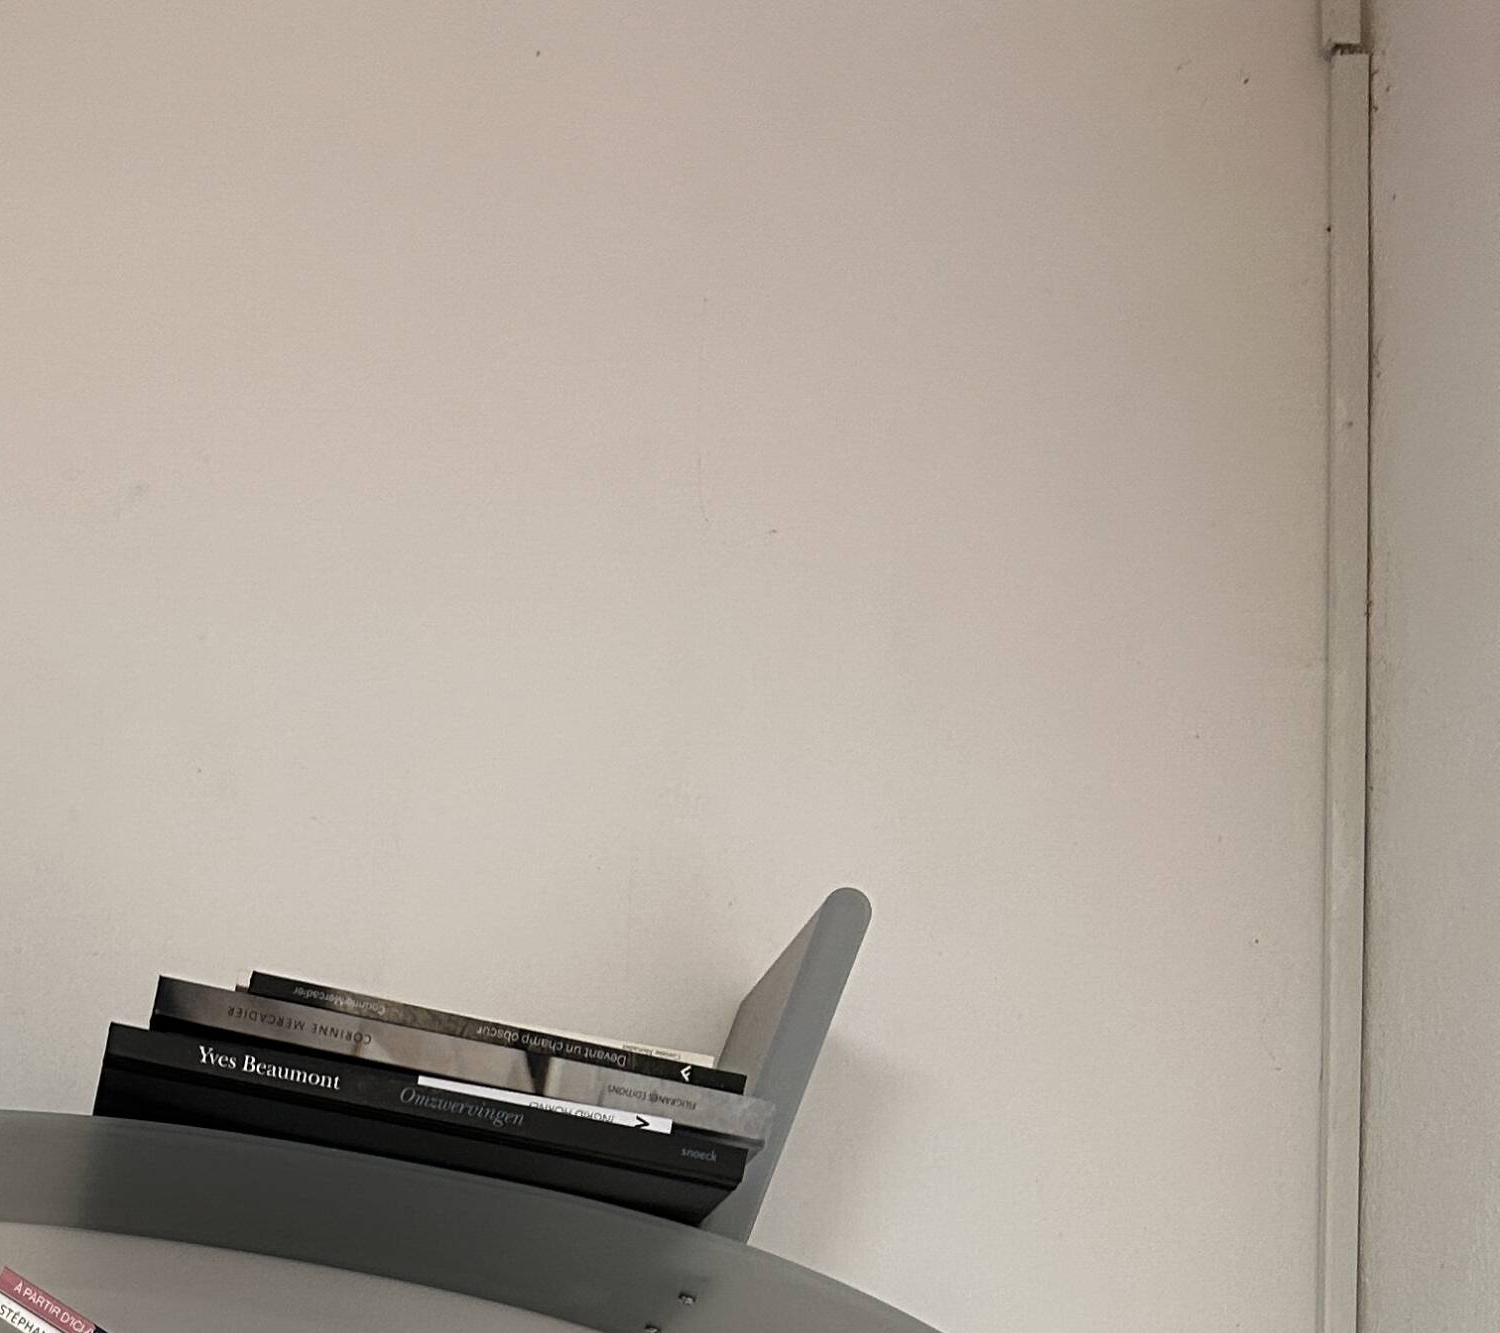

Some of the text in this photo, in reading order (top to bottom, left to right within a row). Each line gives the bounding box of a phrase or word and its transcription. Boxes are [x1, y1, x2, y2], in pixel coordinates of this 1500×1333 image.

[225, 1001, 373, 1047] CORINNE MERCADIER
[519, 1029, 565, 1054] champ
[564, 1041, 582, 1055] un
[582, 1044, 627, 1068] Devant
[195, 1043, 344, 1091] Yves Beaumont
[398, 1084, 526, 1133] Omzwervingen
[680, 1143, 719, 1163] snoeck
[11, 1279, 25, 1295] À
[19, 1286, 63, 1319] PARTIR
